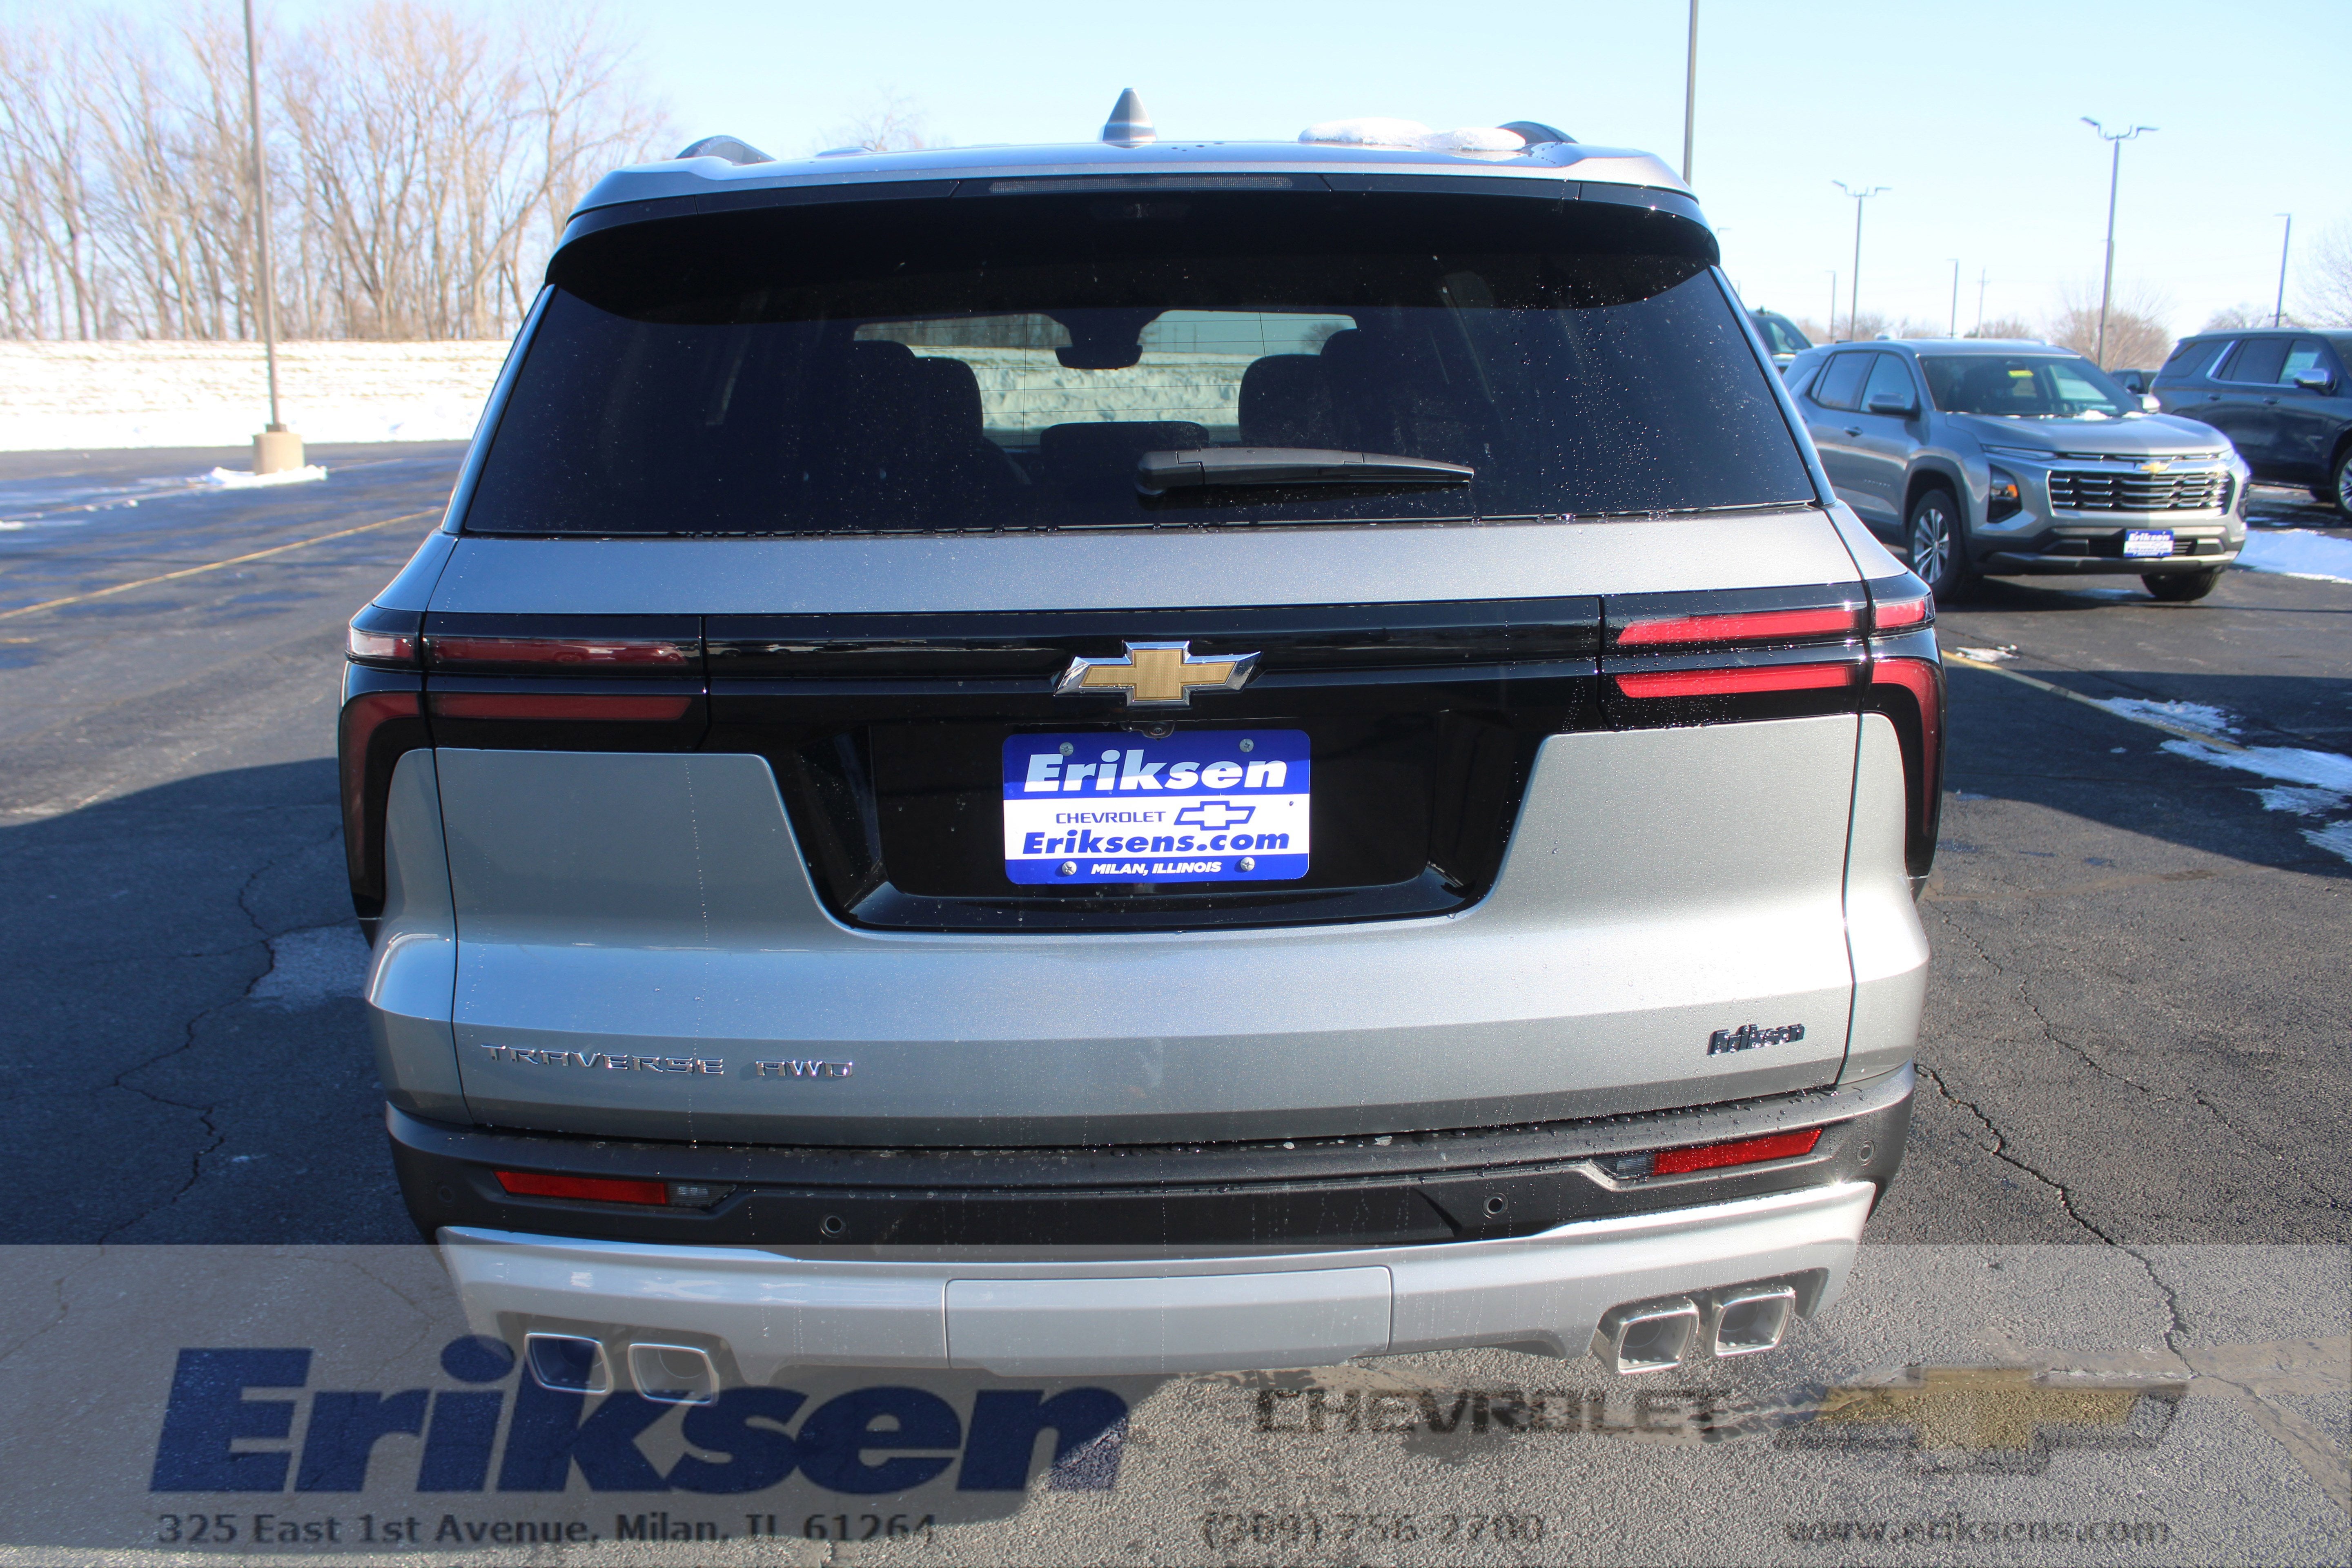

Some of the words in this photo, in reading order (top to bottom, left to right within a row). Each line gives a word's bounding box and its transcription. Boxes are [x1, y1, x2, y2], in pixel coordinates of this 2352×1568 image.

[1023, 749, 1288, 793] Eriksen
[1056, 811, 1167, 824] CHEVROLET
[1022, 830, 1290, 855] Eriksens.com
[1091, 862, 1148, 876] MILAN,
[1152, 861, 1222, 874] ILLINOIS
[480, 1043, 724, 1075] TRAVERSE
[755, 1060, 853, 1077] AWD
